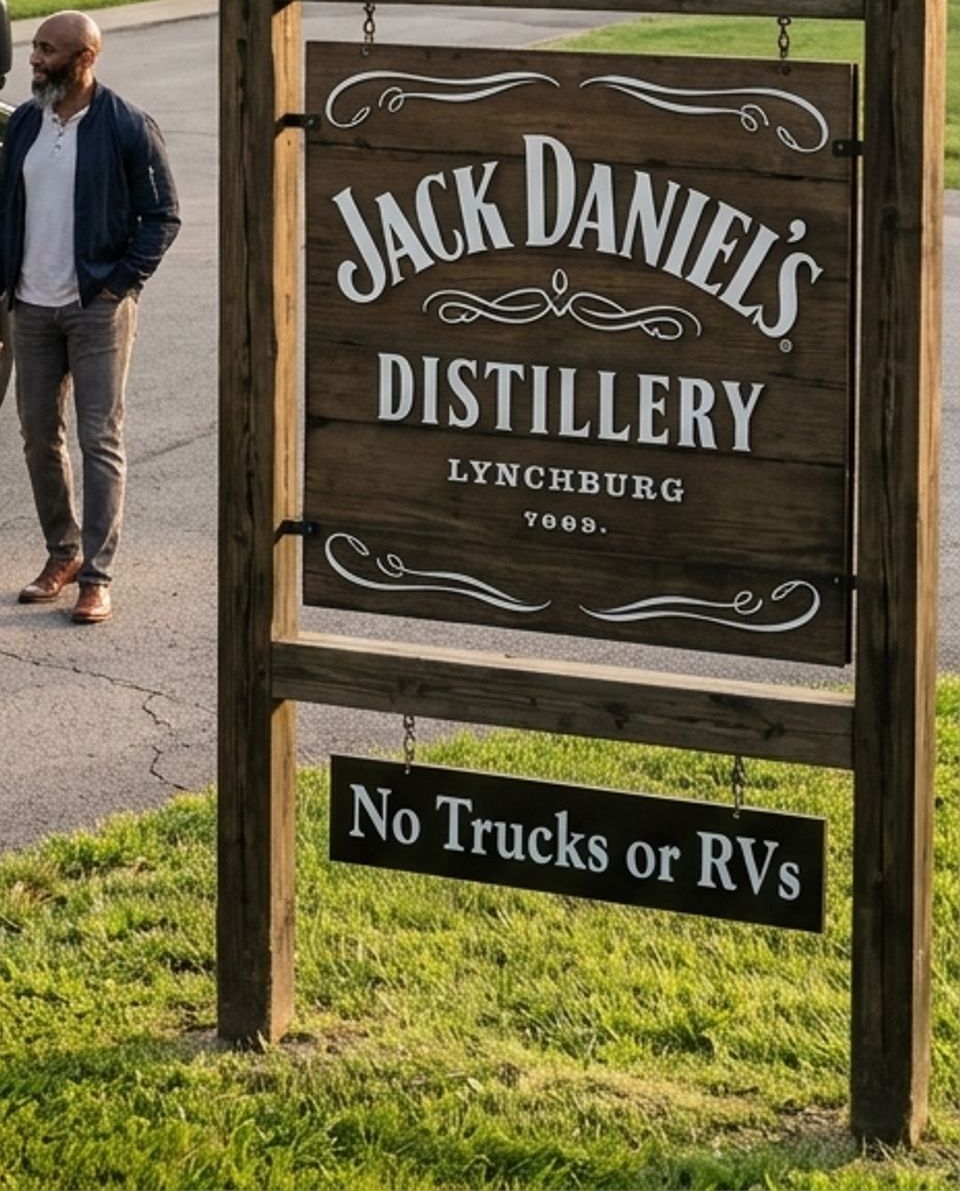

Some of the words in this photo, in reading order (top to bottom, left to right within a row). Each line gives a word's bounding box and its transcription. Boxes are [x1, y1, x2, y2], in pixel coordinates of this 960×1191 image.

[331, 161, 515, 304] JACK
[522, 133, 824, 339] DANIEL'S
[377, 352, 765, 453] DISTILLERY
[447, 458, 685, 503] LYNCHBURG
[348, 783, 420, 845] No
[435, 794, 609, 873] Trucks
[625, 840, 681, 882] or
[696, 830, 801, 901] RVs
